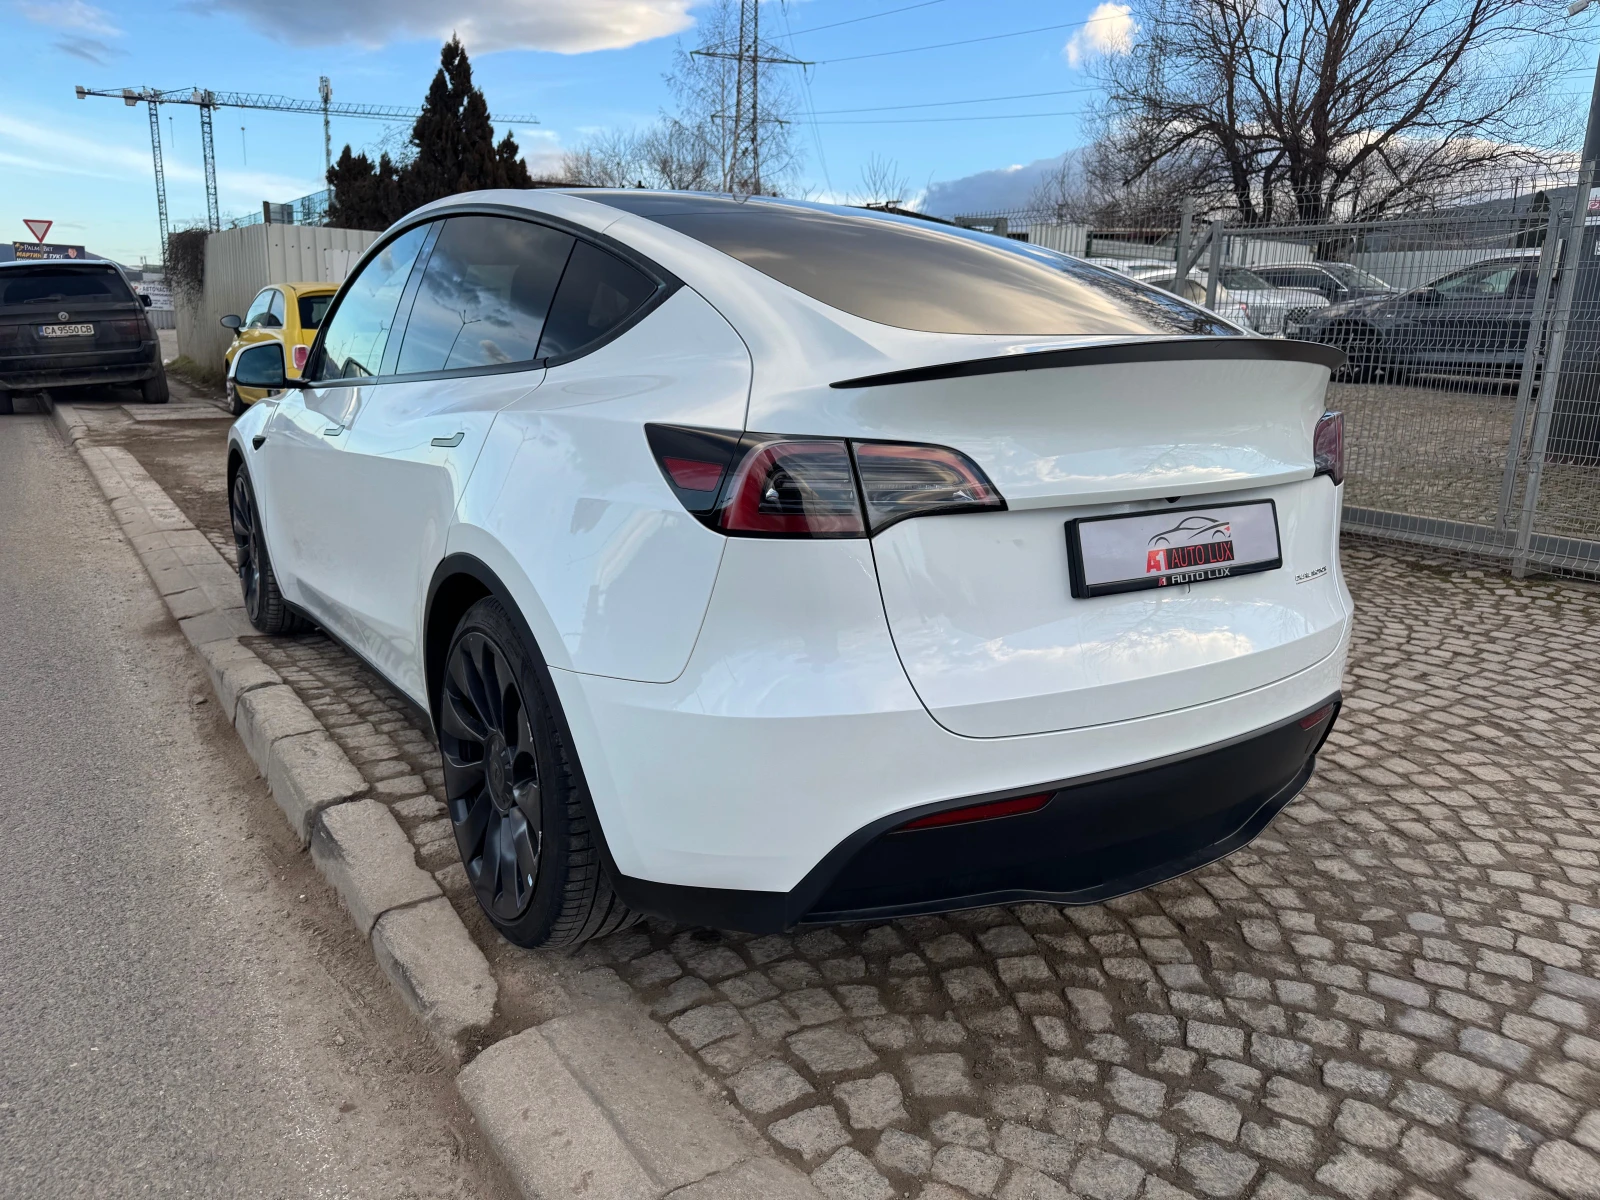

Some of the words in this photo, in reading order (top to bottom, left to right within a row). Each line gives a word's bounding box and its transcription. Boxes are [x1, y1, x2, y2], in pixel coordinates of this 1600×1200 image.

[44, 326, 57, 335] CA
[57, 325, 80, 334] 9550
[80, 325, 93, 334] CB
[1171, 545, 1205, 568] AUTO
[1208, 541, 1233, 563] LUX
[1171, 571, 1205, 584] AUTO
[1208, 567, 1231, 579] LUX
